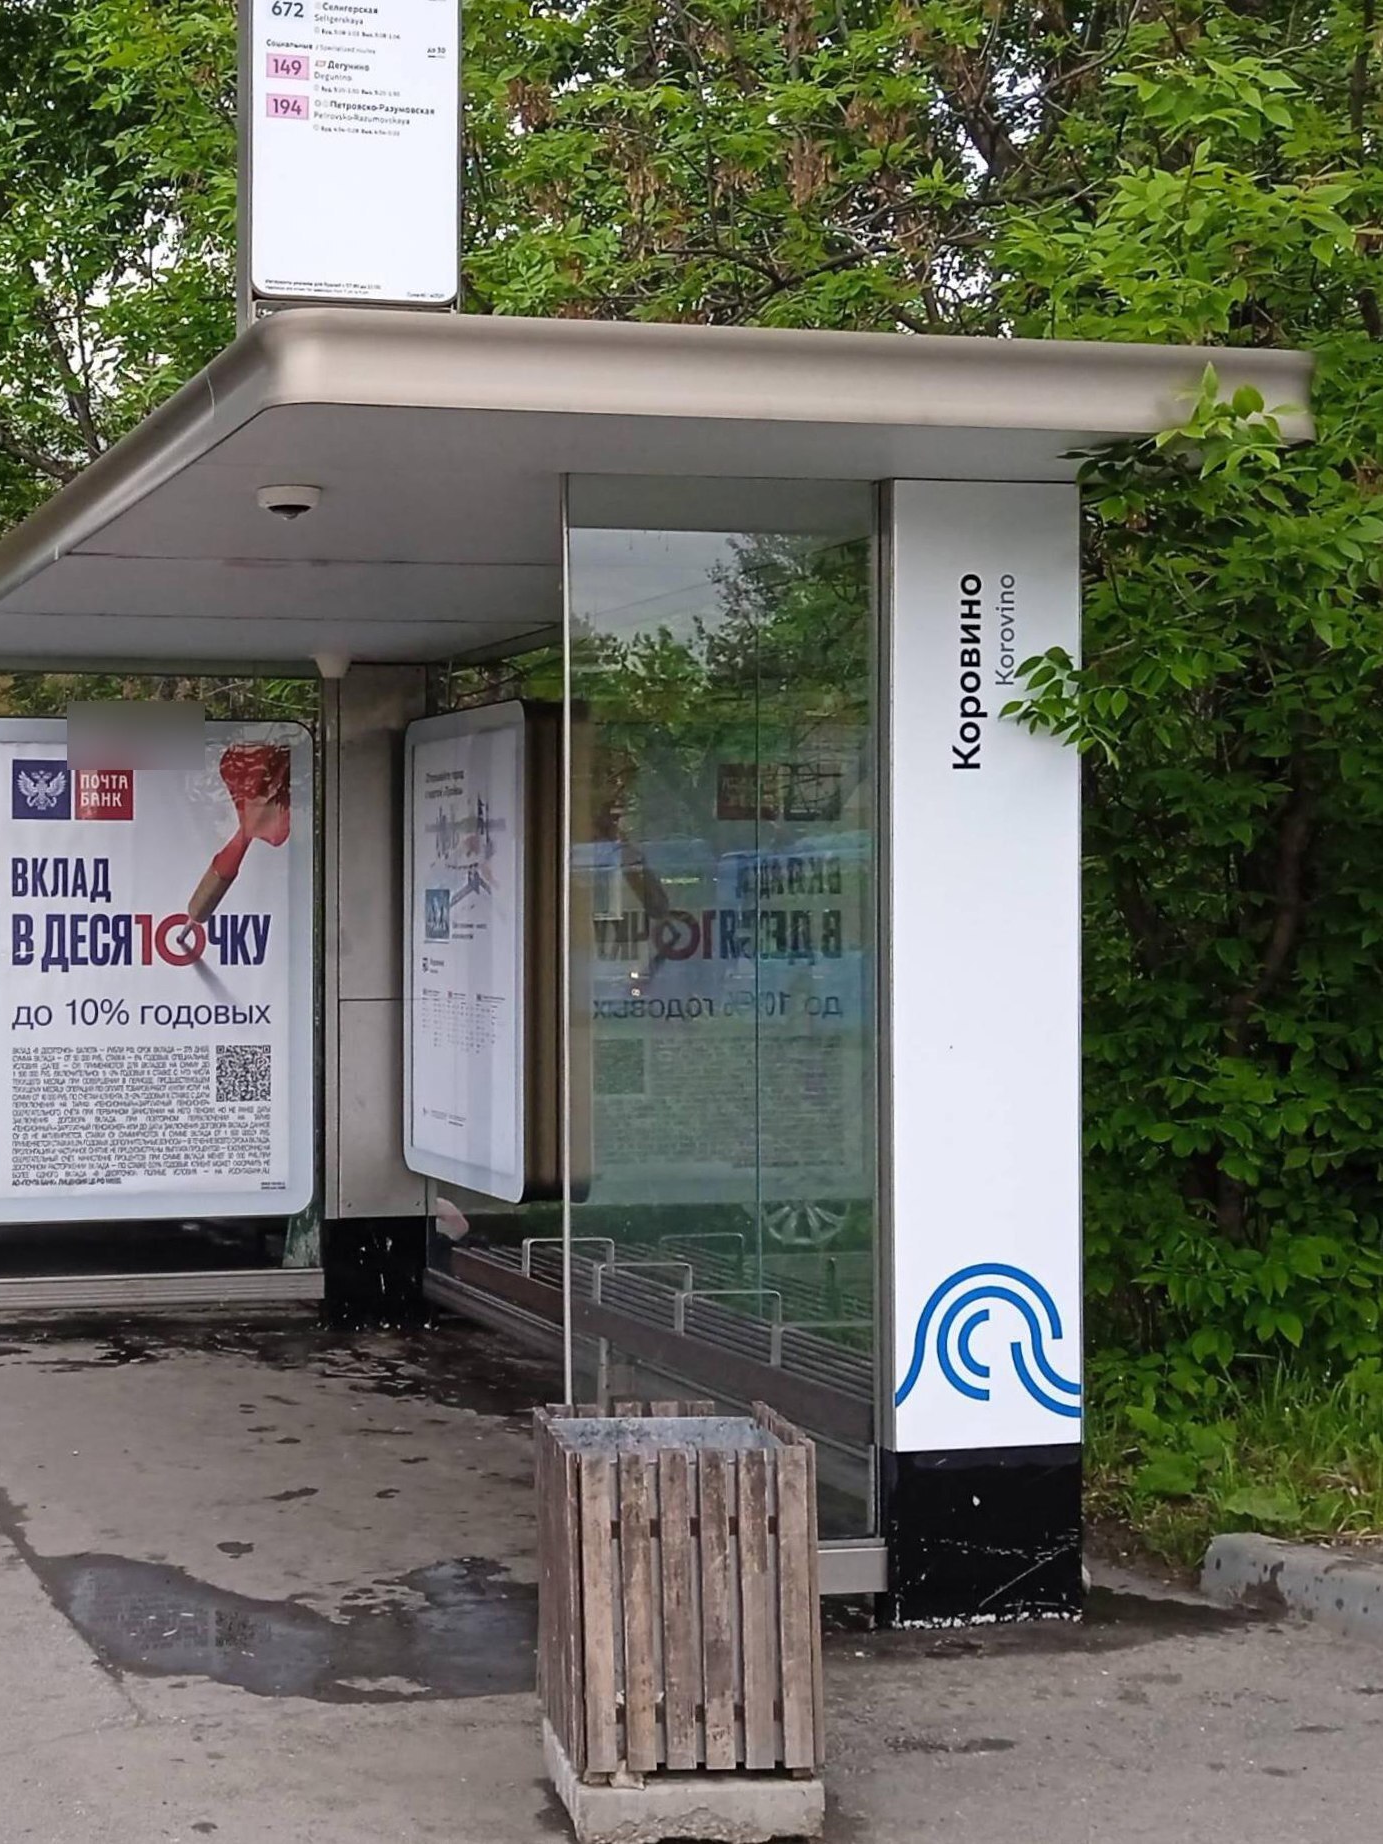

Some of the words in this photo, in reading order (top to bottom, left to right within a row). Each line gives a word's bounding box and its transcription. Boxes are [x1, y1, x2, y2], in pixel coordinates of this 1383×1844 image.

[271, 0, 304, 18] 672
[322, 2, 378, 14] Селигерская
[273, 58, 302, 76] 149
[327, 60, 370, 72] Дегунино
[272, 98, 302, 116] 194
[330, 100, 435, 115] Петровско-Разумовская
[995, 574, 1015, 686] Korovino
[952, 574, 988, 769] Коровино
[80, 774, 128, 790] ПОЧТА
[81, 791, 123, 807] БАНК
[12, 857, 112, 902] ВКЛАД
[12, 914, 35, 966] В
[12, 1004, 53, 1028] до
[66, 999, 130, 1026] 10%
[141, 1004, 272, 1028] годовых
